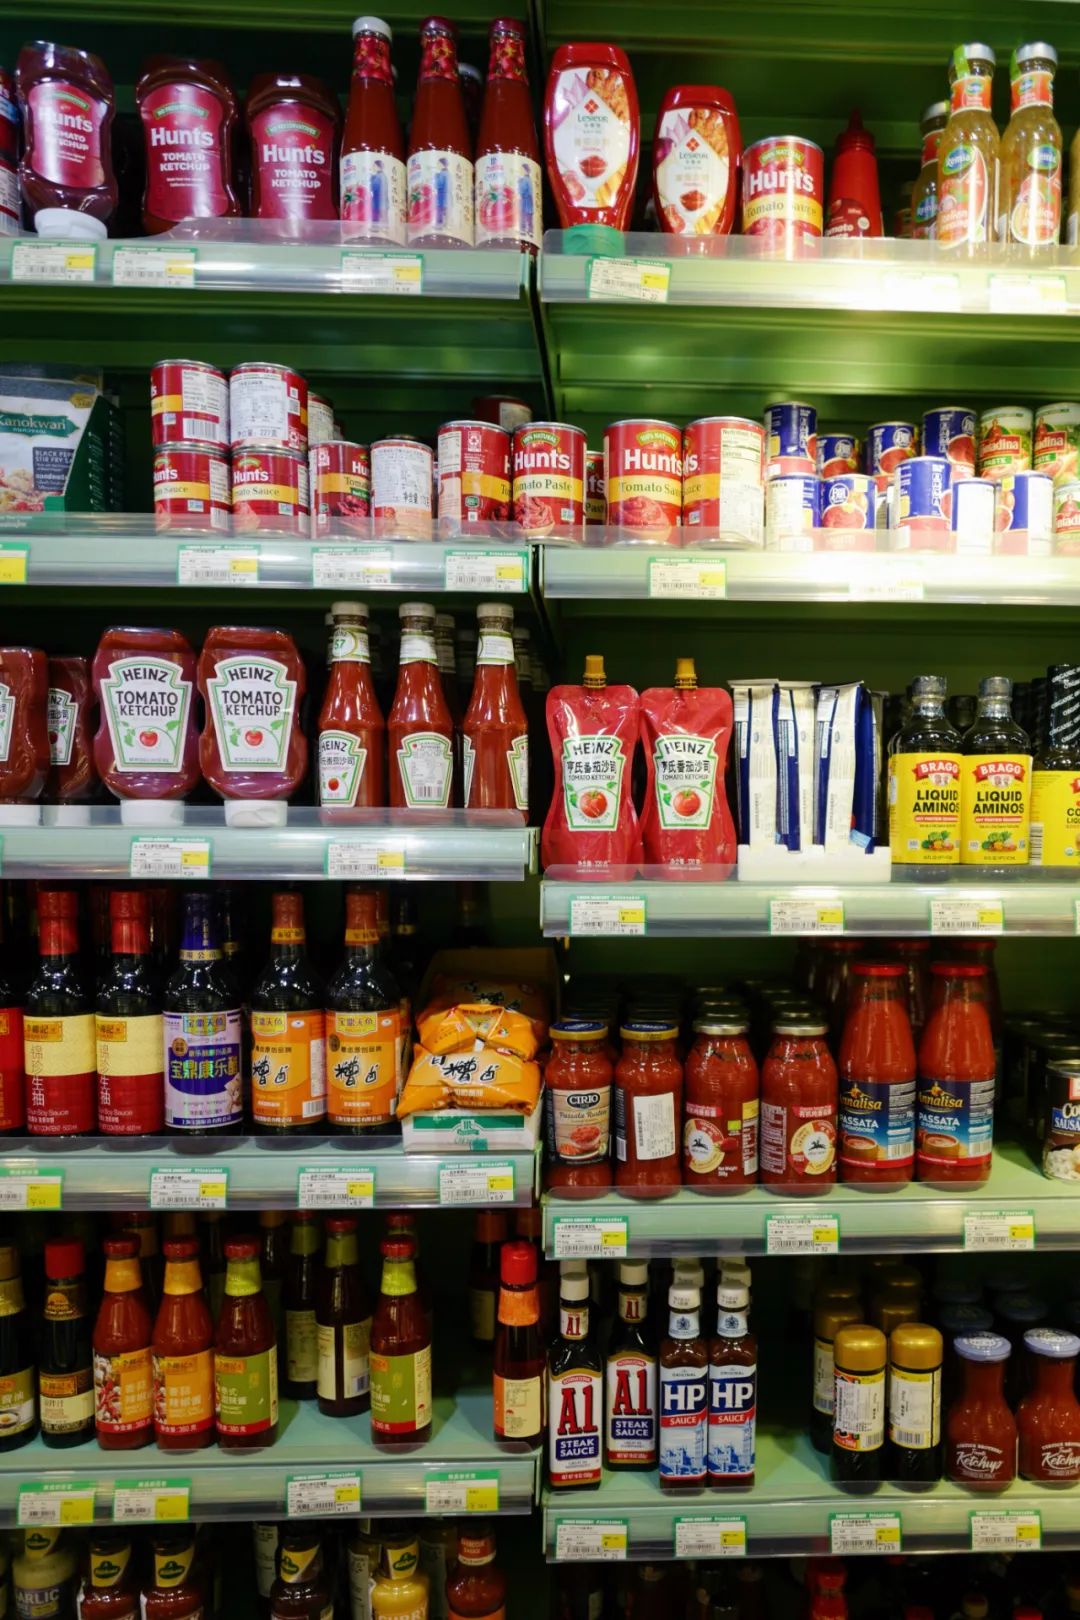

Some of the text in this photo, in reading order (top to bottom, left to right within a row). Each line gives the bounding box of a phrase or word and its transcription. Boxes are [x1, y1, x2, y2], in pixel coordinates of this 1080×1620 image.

[162, 152, 206, 166] TOMATO
[160, 163, 210, 176] KETCHUP
[274, 168, 318, 180] TOMATO
[271, 178, 321, 193] KETCHUP
[515, 480, 541, 495] omato
[333, 638, 345, 650] 57
[122, 667, 169, 683] HEINZ
[228, 666, 274, 682] HEINZ
[115, 690, 178, 706] TOMATO
[221, 690, 283, 705] TOMATO
[119, 704, 172, 717] KETCHUP
[225, 704, 281, 717] KETCHUP
[573, 742, 613, 756] HEINZ
[664, 741, 706, 755] HEINZ
[920, 763, 958, 774] BRAGG
[979, 764, 1021, 775] BRAGG
[567, 774, 590, 782] TOMATO
[916, 789, 958, 801] LIQUID
[976, 790, 1022, 802] LIQUID
[912, 802, 960, 814] AMINOS
[972, 803, 1025, 815] AMINOS
[568, 1093, 599, 1105] CIRIO
[841, 1113, 879, 1129] PASSATA
[919, 1111, 961, 1127] PASSATA
[1054, 1116, 1080, 1132] SAUSA
[565, 1316, 581, 1336] A1
[611, 1368, 653, 1416] A1
[664, 1383, 705, 1411] HP
[712, 1381, 754, 1409] HP
[557, 1384, 599, 1436] A1
[615, 1420, 648, 1428] STEAK
[670, 1416, 697, 1426] SAUCE
[718, 1414, 745, 1424] SAUCE
[615, 1427, 648, 1437] SAUCE
[560, 1439, 594, 1449] STEAK
[560, 1447, 595, 1458] SAUCE
[957, 1452, 1003, 1474] Ketchup
[16, 1588, 60, 1606] ARLIC
